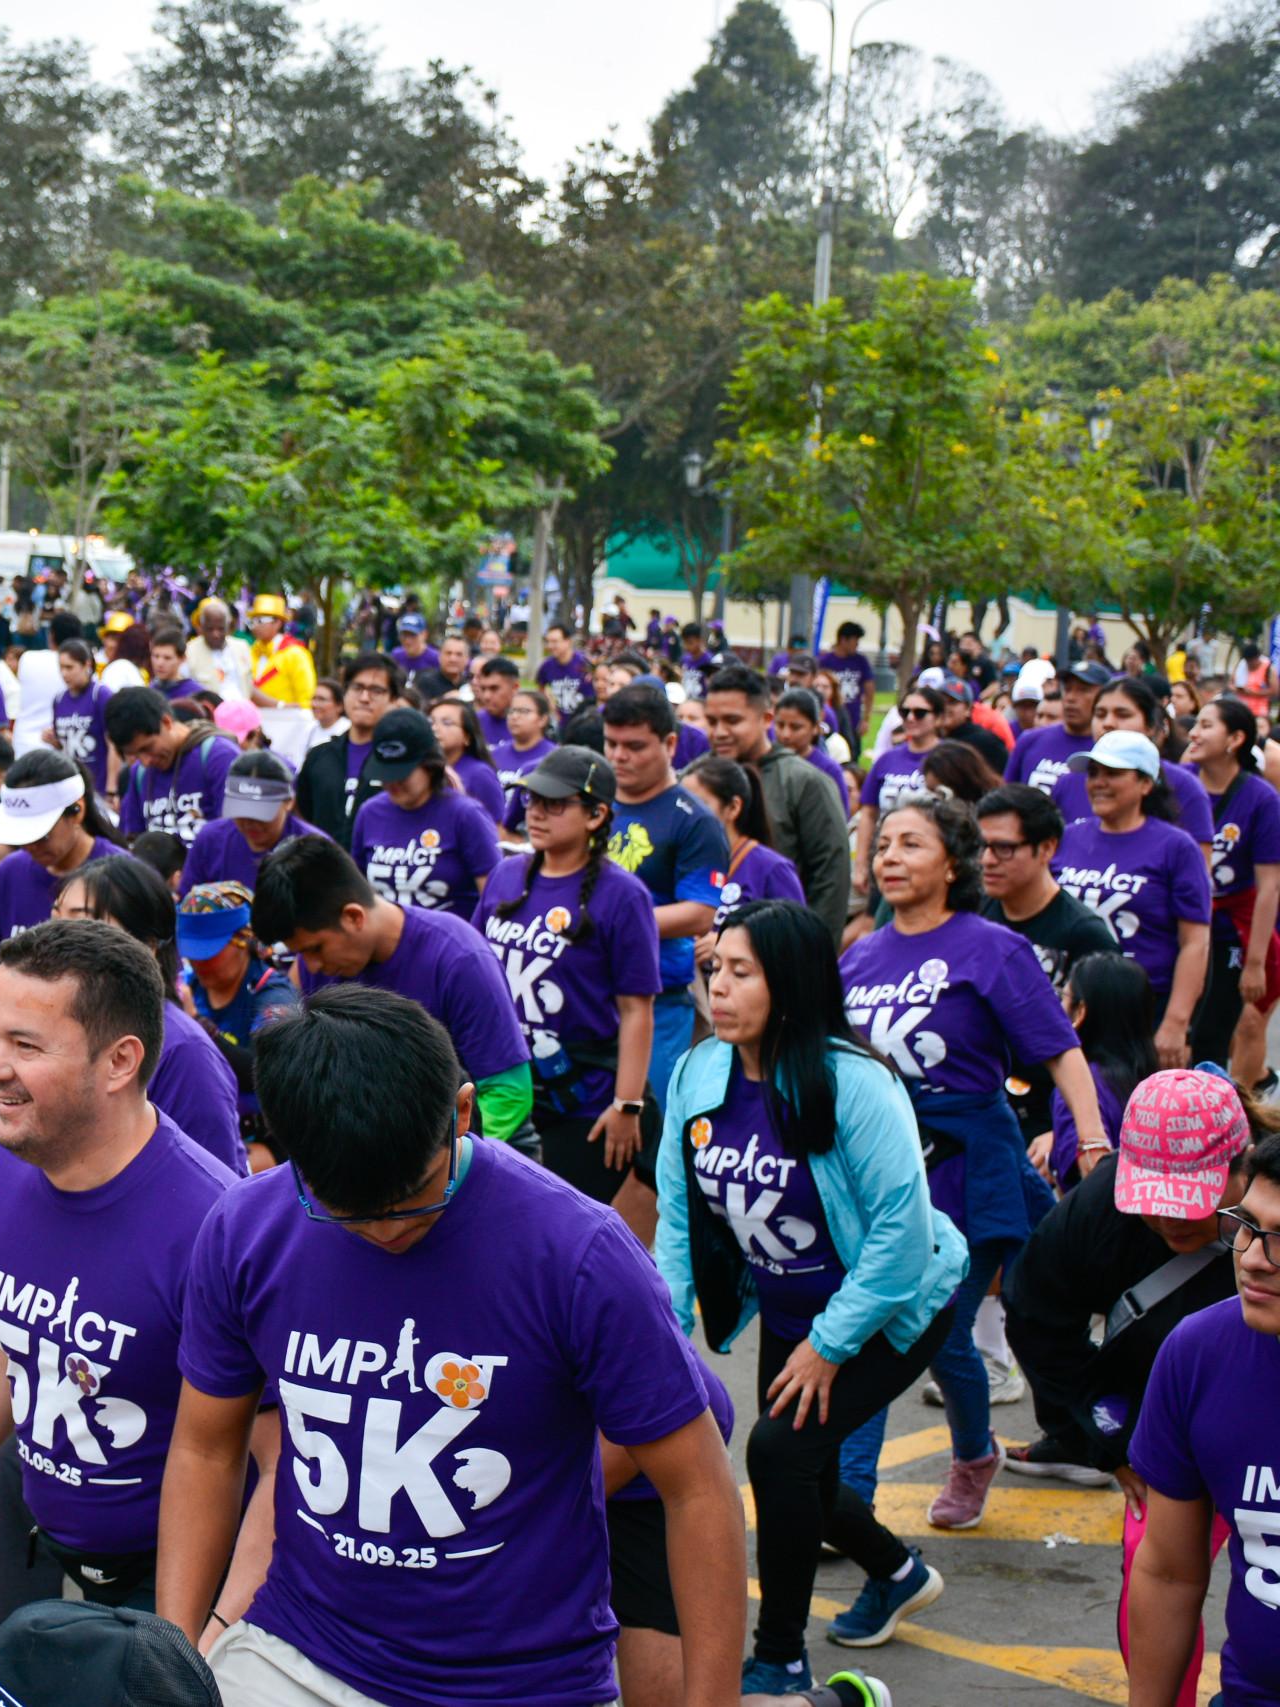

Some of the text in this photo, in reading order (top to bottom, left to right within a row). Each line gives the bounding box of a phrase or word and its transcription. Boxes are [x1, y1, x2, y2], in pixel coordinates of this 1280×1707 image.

[844, 970, 950, 1006] IMPACT
[1131, 1180, 1206, 1210] ITALIA
[278, 1377, 481, 1539] 5K
[331, 1533, 438, 1569] 21.09.25
